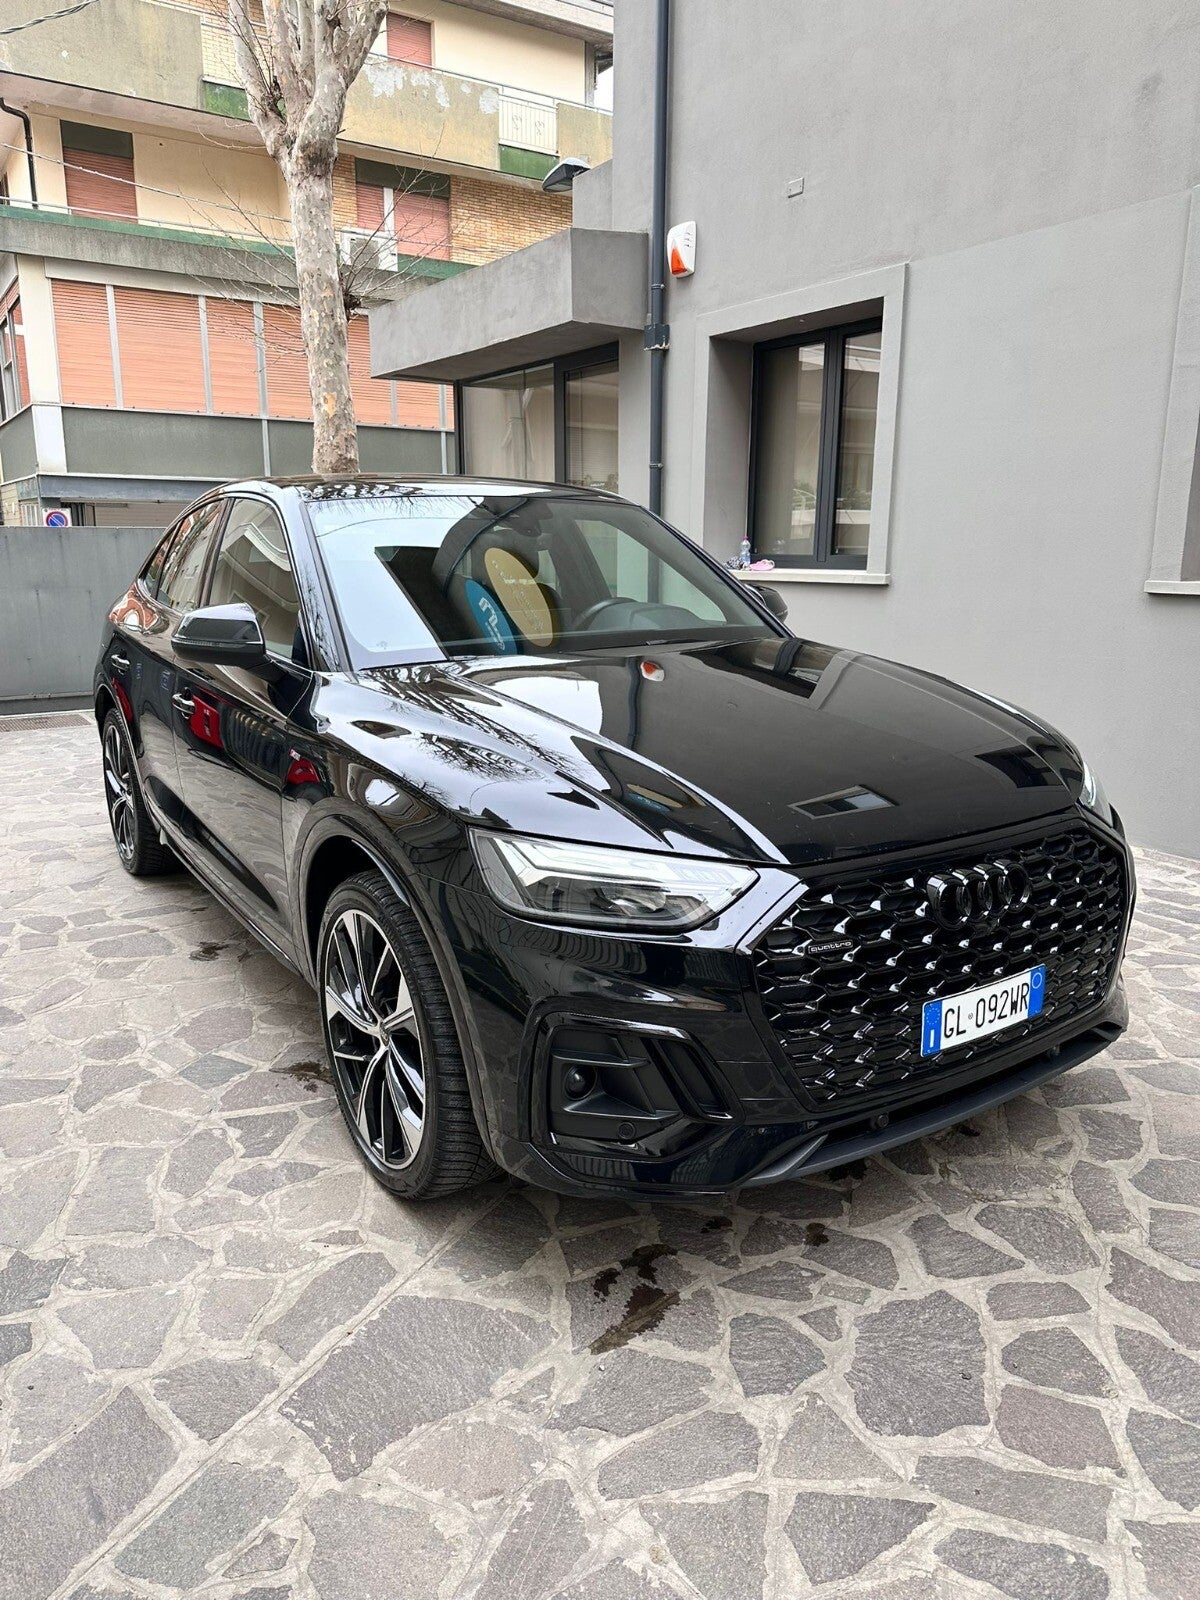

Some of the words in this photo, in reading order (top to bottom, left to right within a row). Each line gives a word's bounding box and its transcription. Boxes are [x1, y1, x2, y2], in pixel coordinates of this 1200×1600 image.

[811, 941, 852, 952] quattro
[944, 1005, 966, 1039] GL
[975, 982, 1030, 1028] 092WR
[929, 1029, 935, 1048] I
